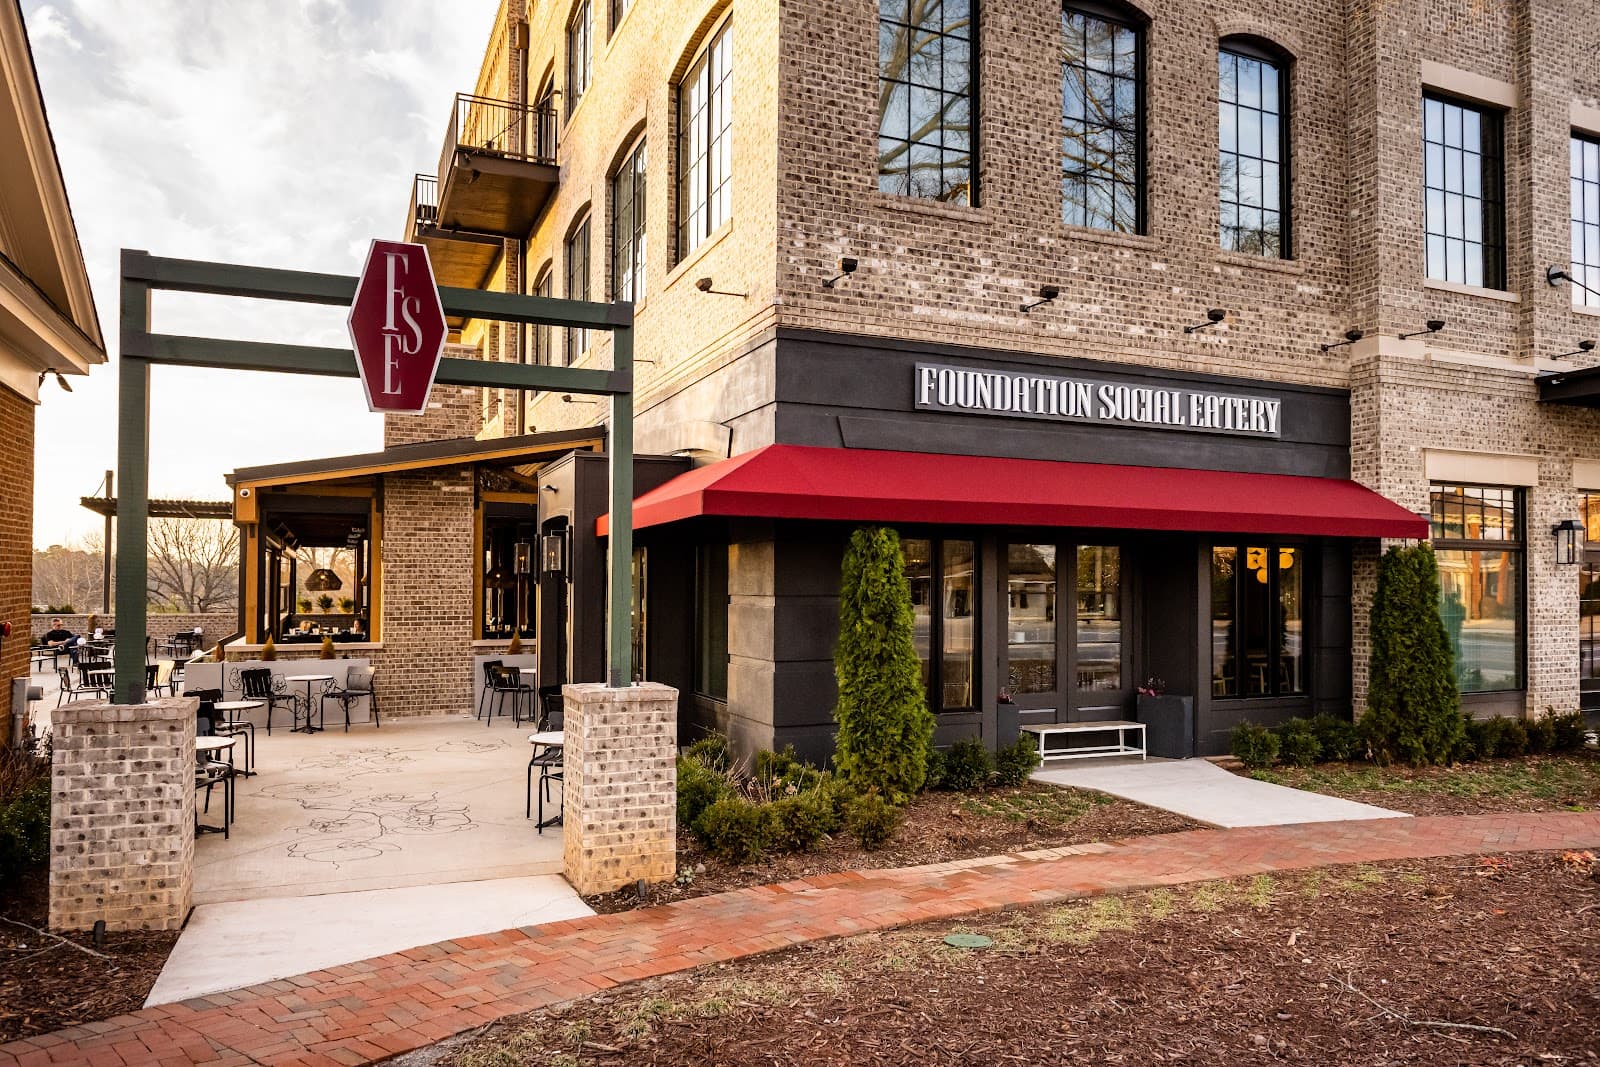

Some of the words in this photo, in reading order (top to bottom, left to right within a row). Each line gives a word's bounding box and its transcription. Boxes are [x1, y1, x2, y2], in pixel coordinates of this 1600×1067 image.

[919, 367, 1094, 418] FOUNDATION
[1098, 383, 1185, 426] SOCIAL
[1189, 393, 1281, 434] EATERY
